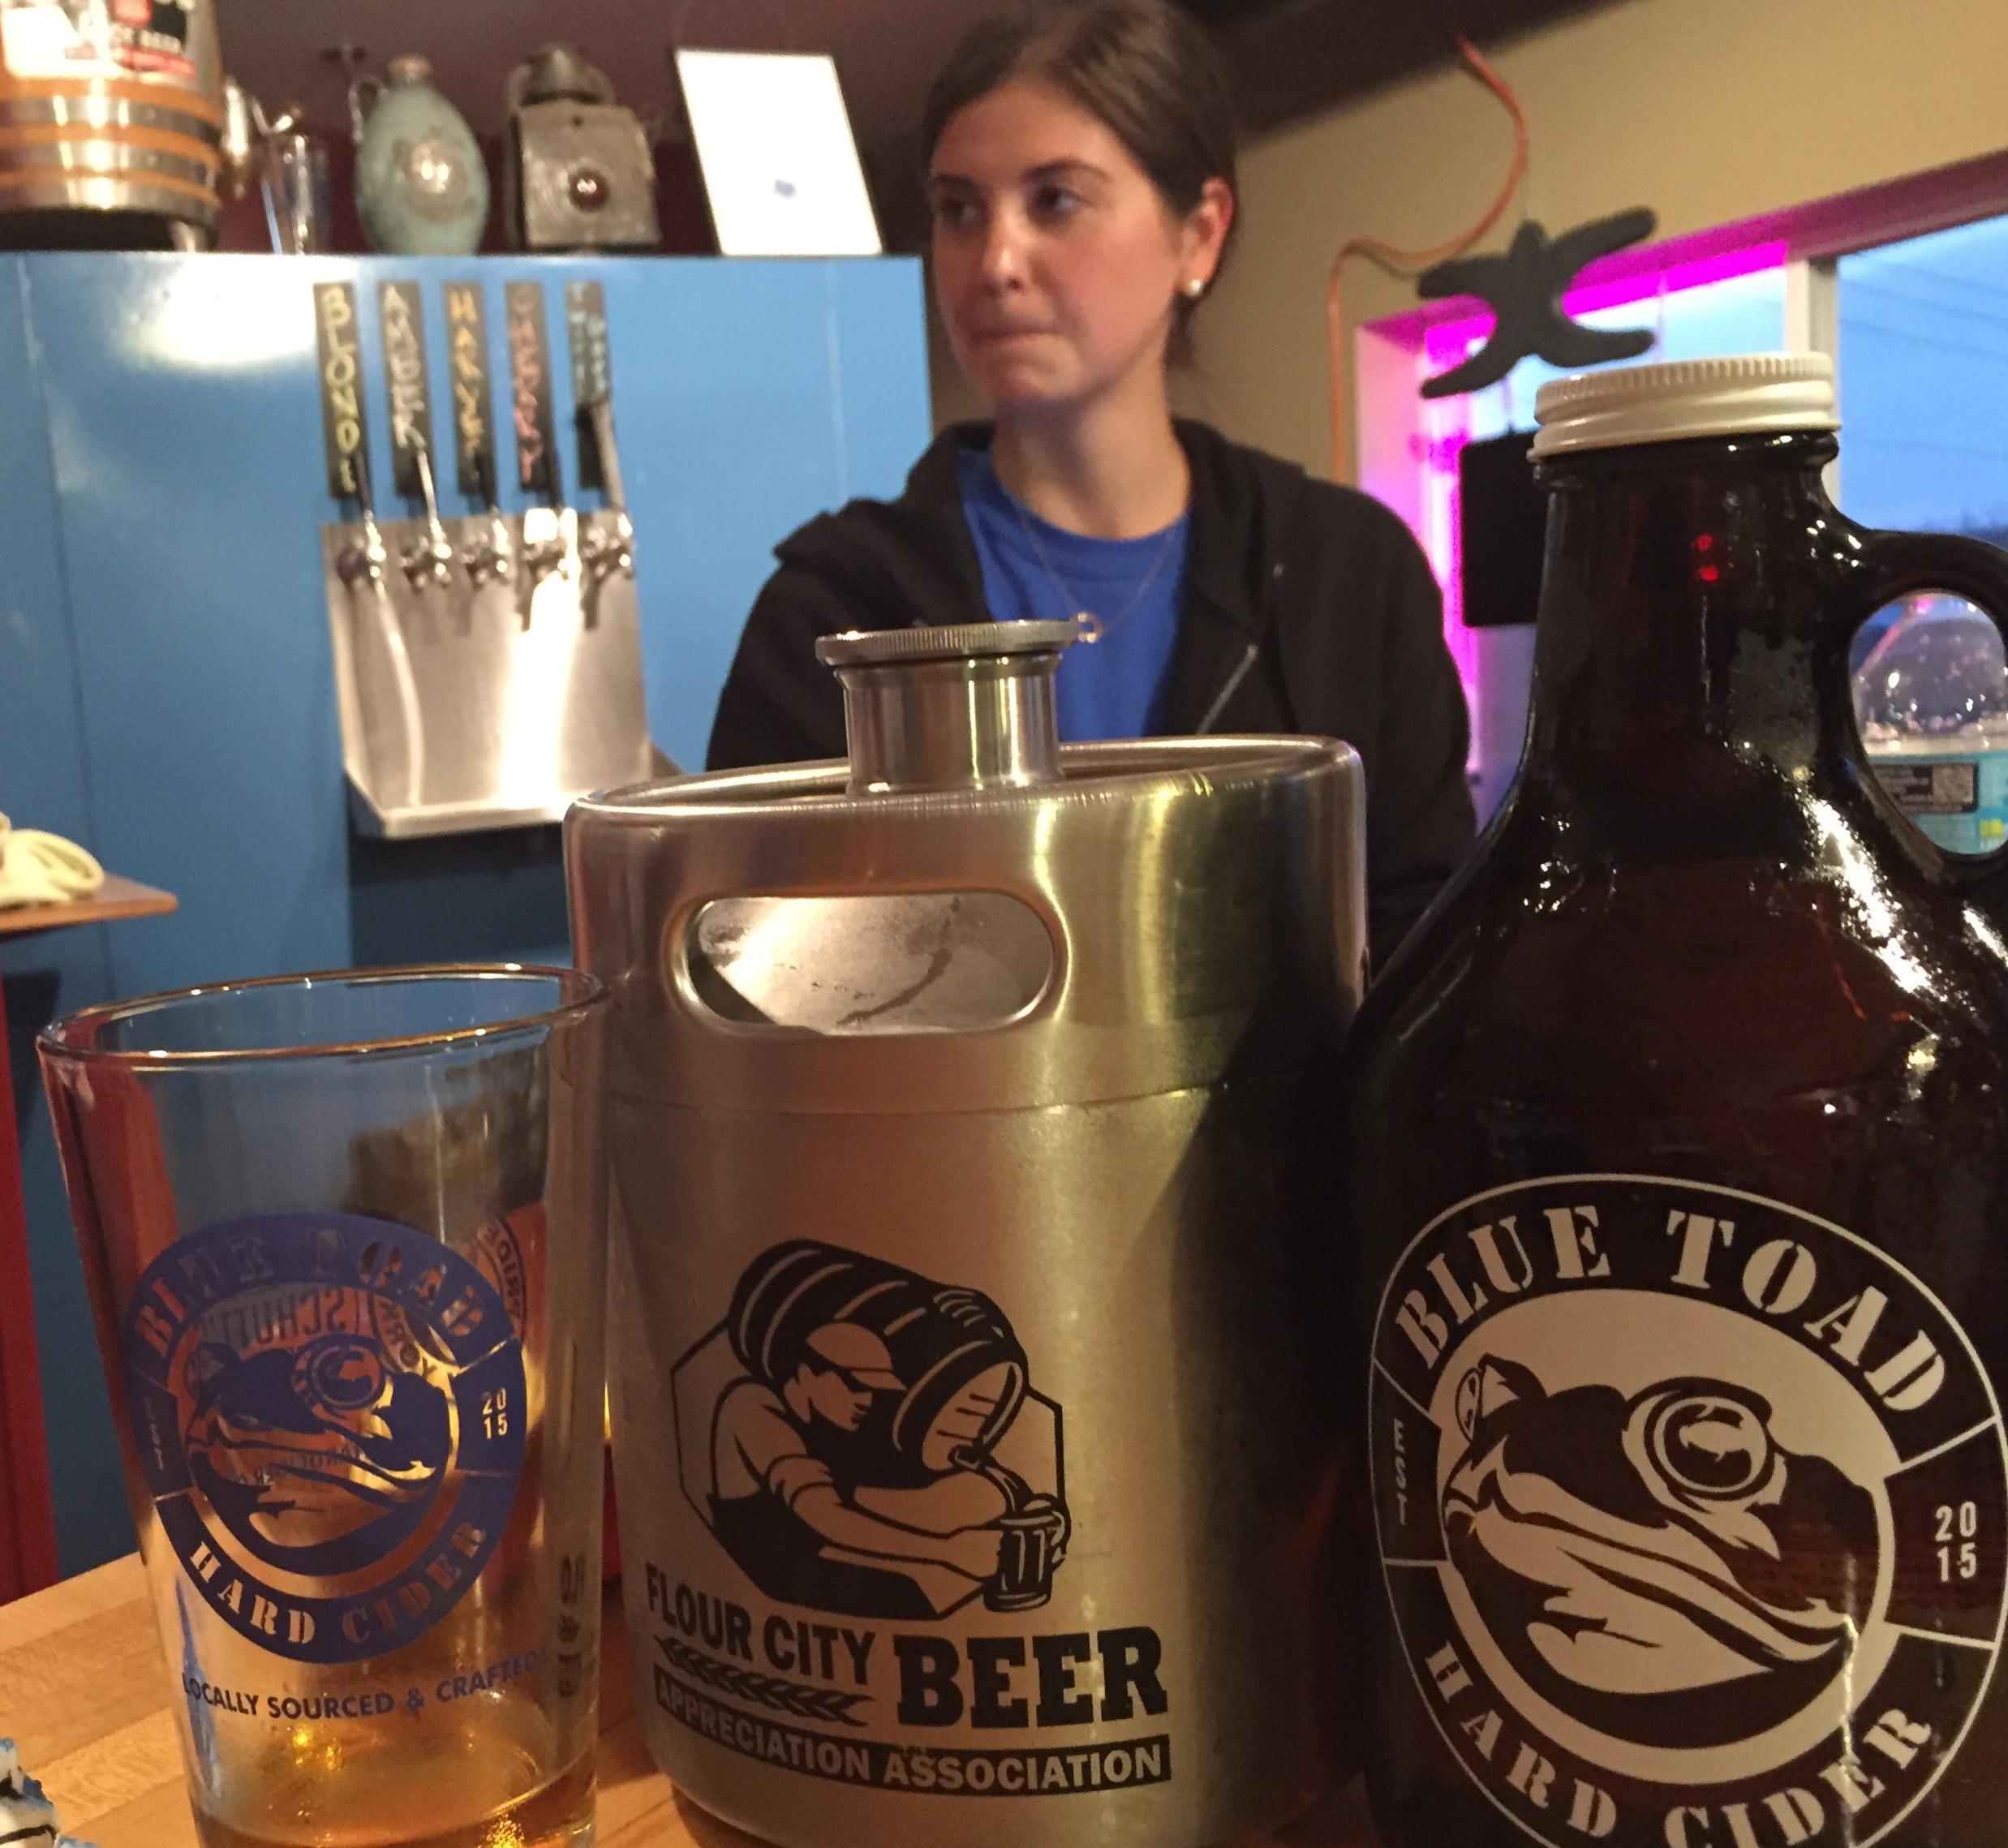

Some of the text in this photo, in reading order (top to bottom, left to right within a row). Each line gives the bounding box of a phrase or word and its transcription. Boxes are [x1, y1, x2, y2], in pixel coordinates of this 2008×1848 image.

[1395, 1205, 1946, 1411] BLUE TOAD
[482, 1387, 507, 1416] 20
[483, 1413, 509, 1440] 15
[1935, 1501, 1977, 1541] 20
[1937, 1542, 1977, 1582] 15
[189, 1540, 316, 1645] HARD
[342, 1521, 486, 1645] CIDER
[181, 1650, 540, 1720] LOCALLY SOURCED & CRAFTED
[646, 1559, 754, 1662] FLOUR
[763, 1614, 876, 1686] CITY
[893, 1626, 1168, 1729] BEER
[657, 1671, 1161, 1790] APPRECIATION ASSOCIATION
[1425, 1641, 1932, 1848] HARD CIDER
